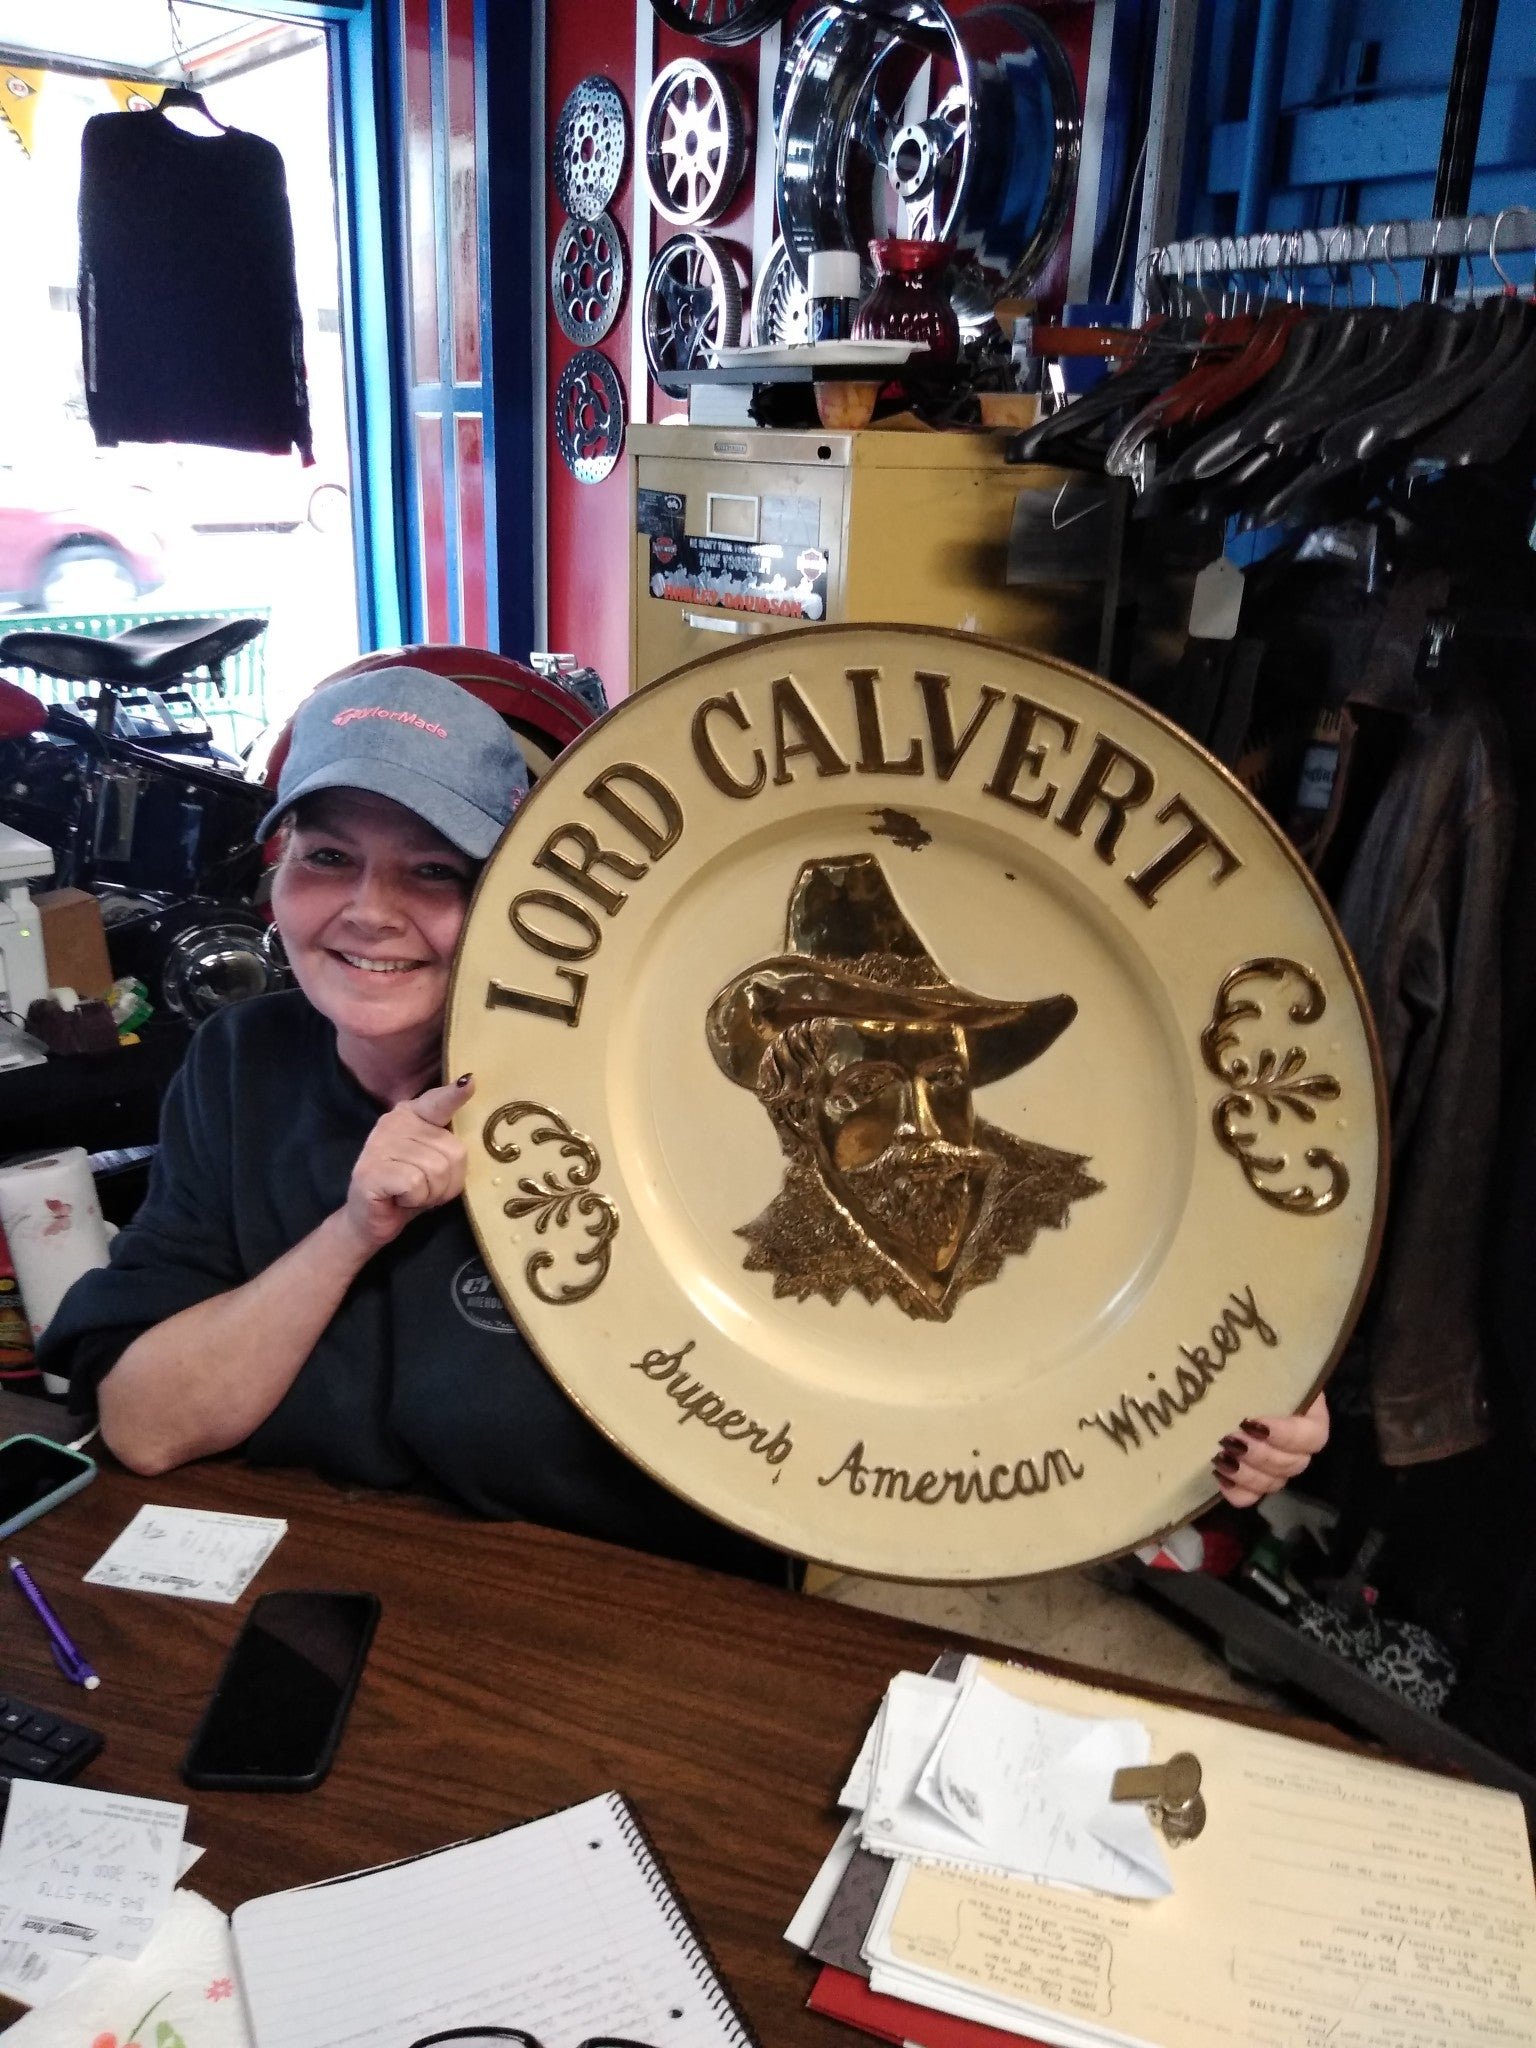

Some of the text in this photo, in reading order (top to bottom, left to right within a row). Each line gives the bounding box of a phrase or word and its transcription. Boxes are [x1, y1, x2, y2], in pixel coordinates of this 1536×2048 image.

[332, 706, 447, 739] TaylorMade
[485, 668, 1243, 1028] LORD CALVERT
[630, 1284, 1279, 1505] Superb American Whiskey
